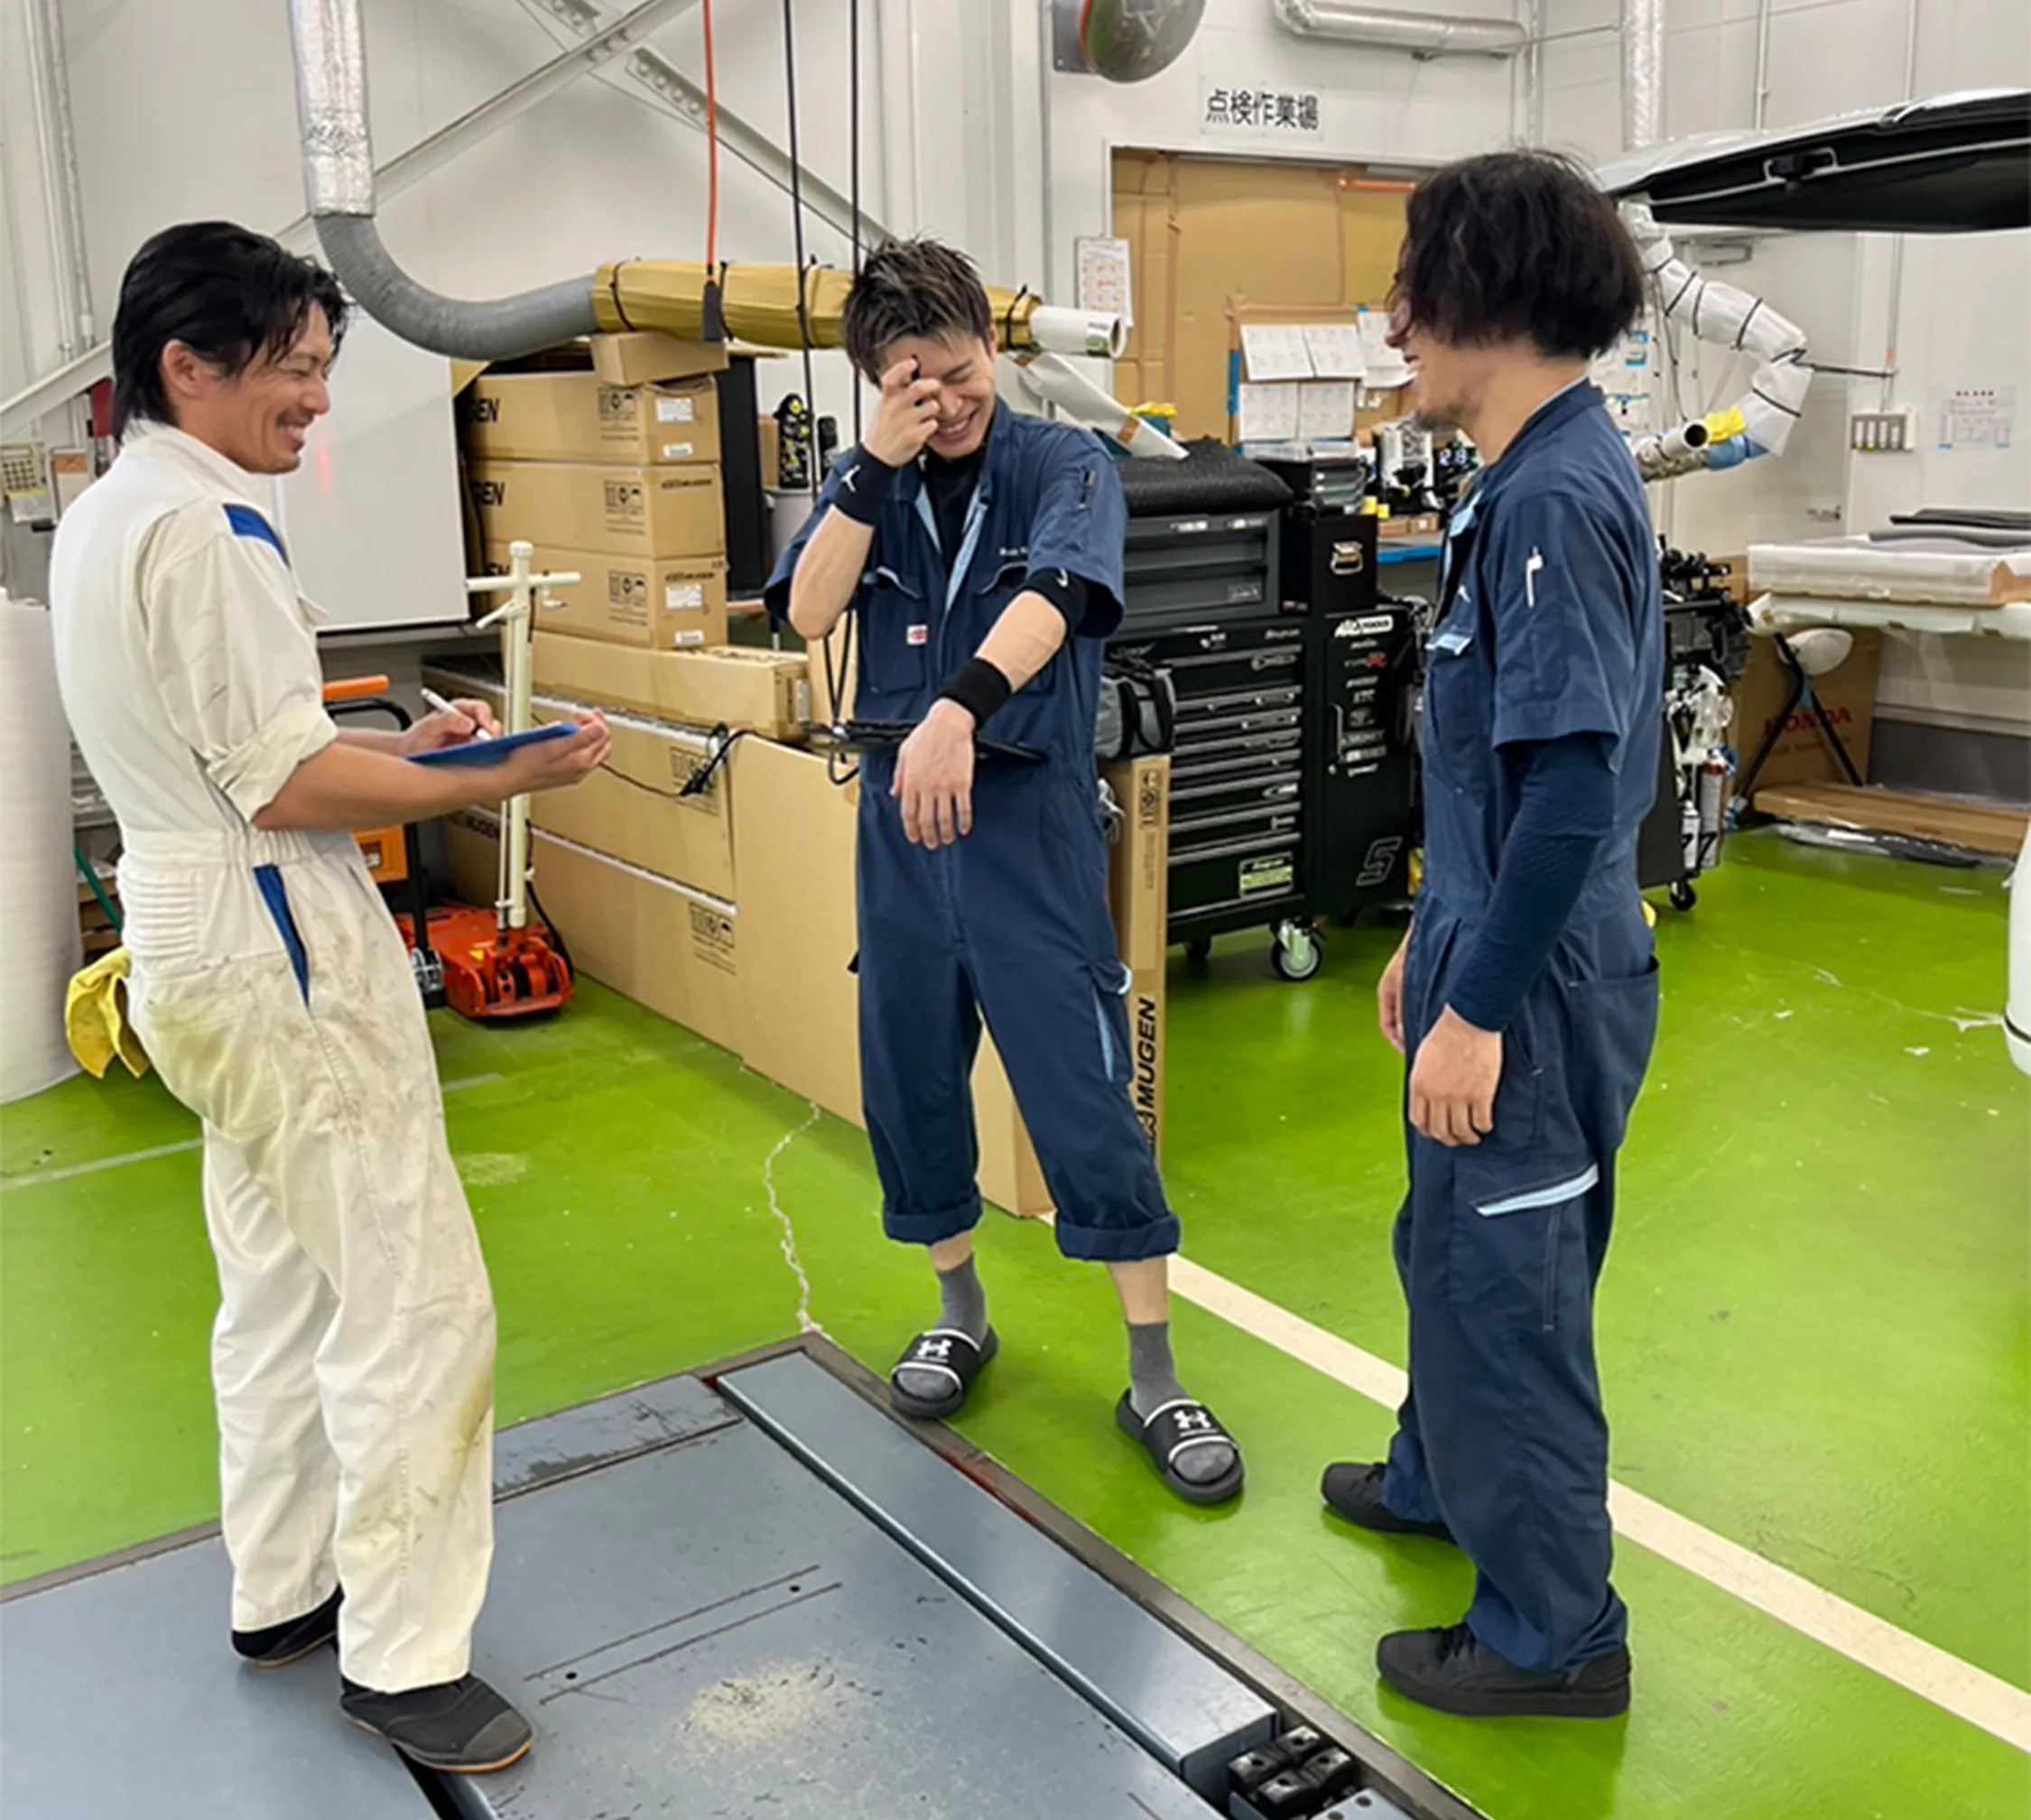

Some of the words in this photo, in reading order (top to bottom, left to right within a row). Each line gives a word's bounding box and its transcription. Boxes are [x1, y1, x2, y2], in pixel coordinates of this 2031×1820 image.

[1205, 88, 1319, 130] 点検作業場
[1136, 996, 1156, 1109] MUGEN
